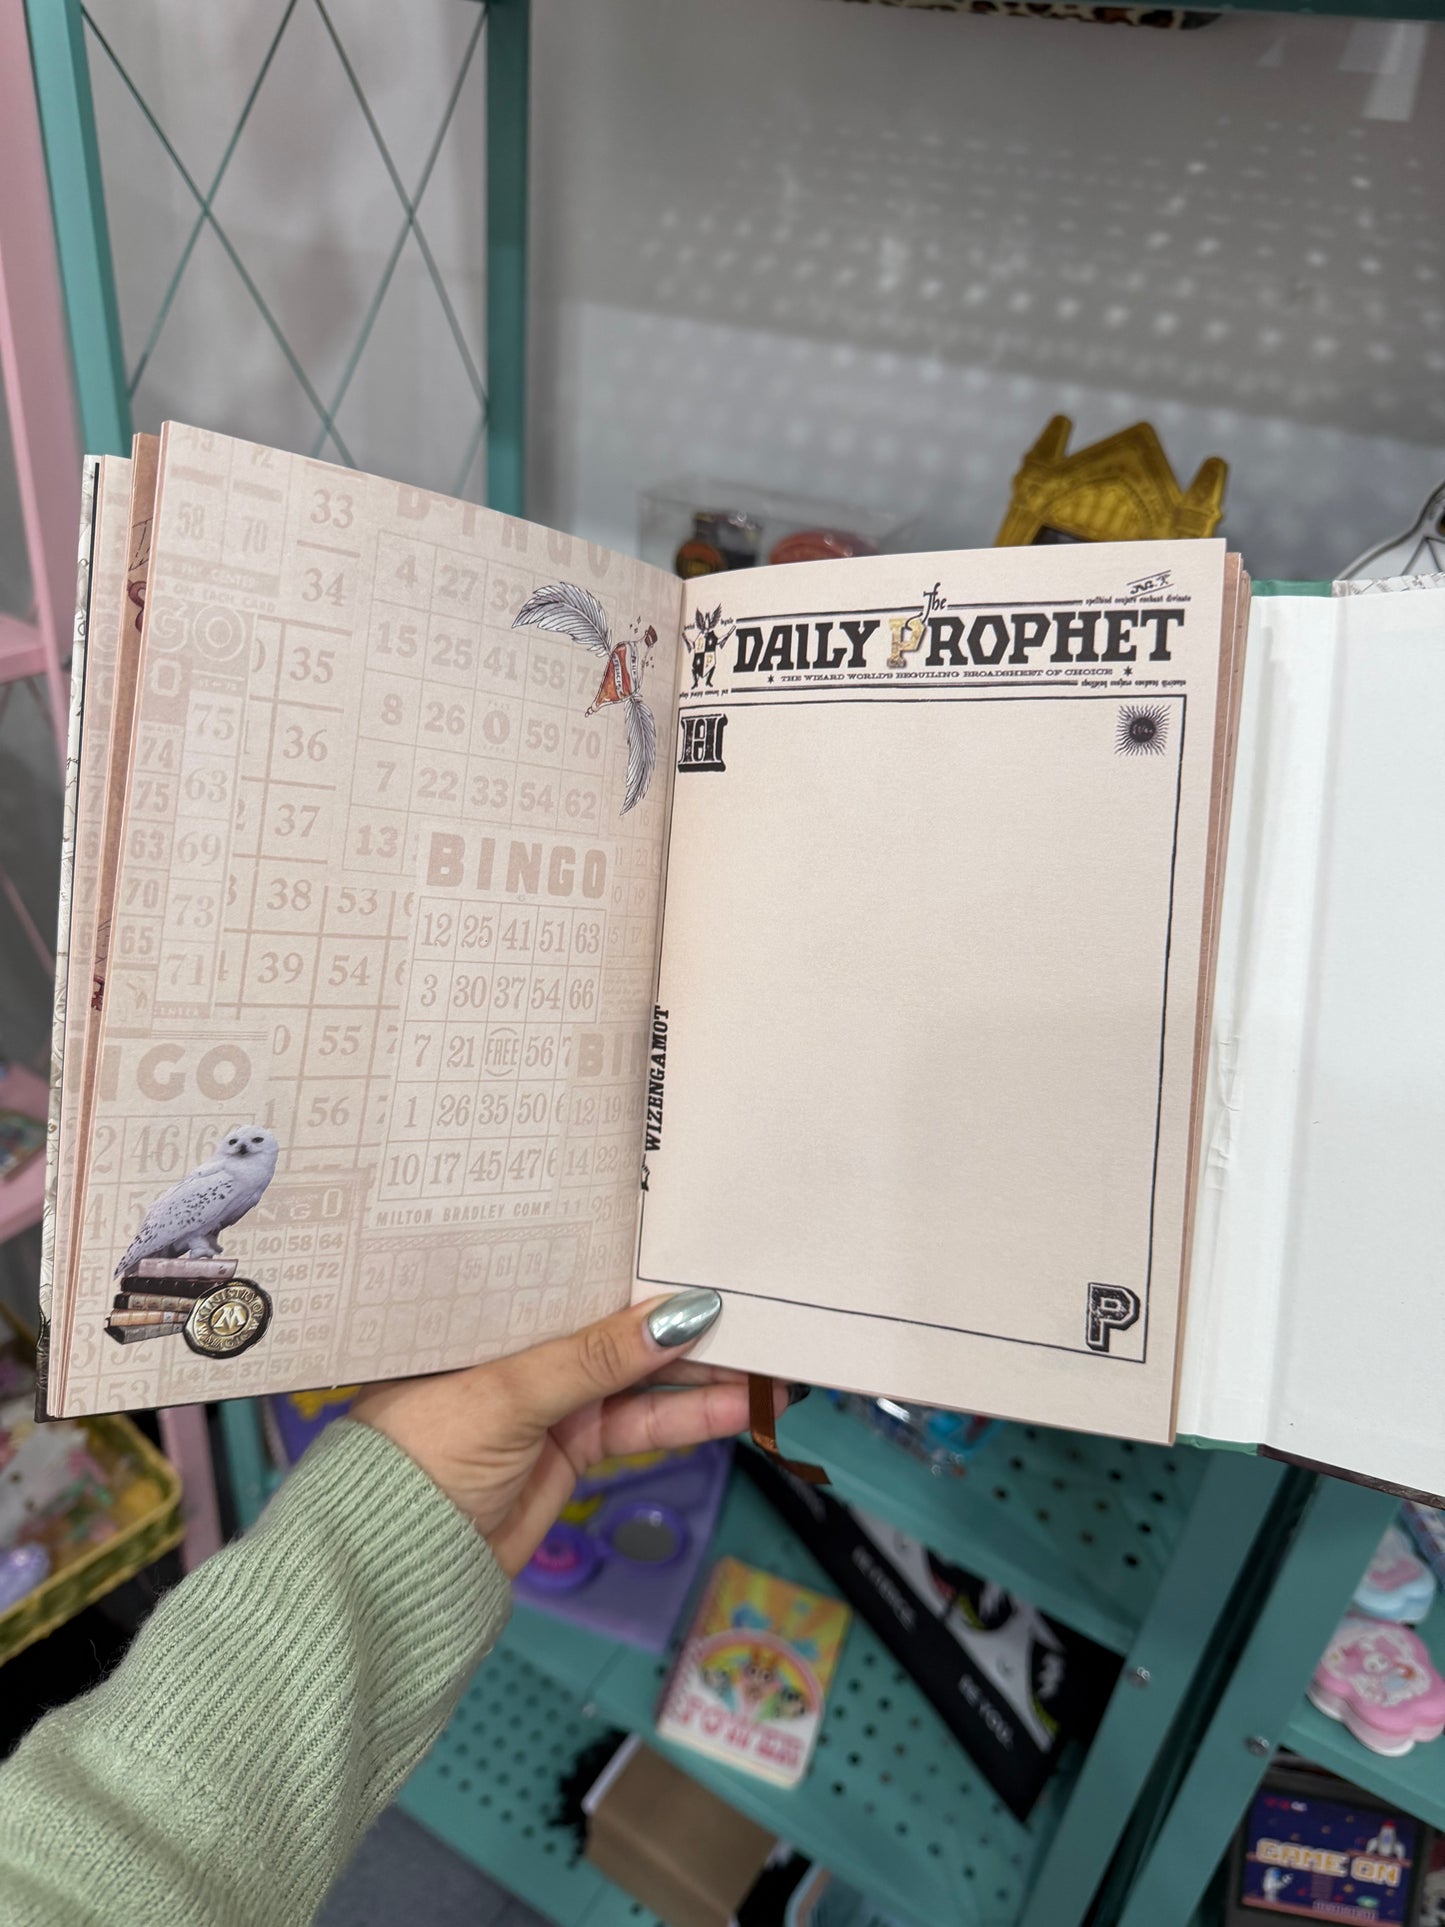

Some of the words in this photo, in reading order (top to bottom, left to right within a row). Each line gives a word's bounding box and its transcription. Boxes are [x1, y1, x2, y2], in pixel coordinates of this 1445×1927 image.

[310, 488, 354, 529] 33
[302, 567, 346, 608] 34
[395, 554, 418, 590] 4
[439, 563, 479, 601] 27
[915, 582, 947, 626] The
[377, 620, 418, 659] 15
[431, 633, 474, 672] 25
[483, 646, 518, 681] 41
[528, 654, 566, 690] 58
[733, 619, 881, 674] DAILY
[886, 608, 1185, 669] PROPHET
[289, 646, 335, 685] 35
[780, 675, 802, 683] THE
[804, 673, 845, 682] WIZARD
[896, 670, 960, 680] BEGUILING
[962, 668, 1044, 679] BROADSHEET
[1045, 668, 1063, 677] OF
[1064, 667, 1113, 677] CHOICE
[283, 725, 328, 762] 36
[380, 692, 404, 726] 8
[423, 701, 466, 736] 26
[525, 720, 560, 753] 59
[571, 726, 601, 759] 70
[134, 780, 170, 814] 75
[184, 767, 228, 804] 63
[377, 760, 397, 793] 7
[416, 766, 458, 801] 22
[471, 775, 509, 810] 33
[519, 781, 556, 813] 54
[564, 789, 596, 820] 62
[274, 803, 321, 838] 37
[129, 829, 166, 861] 63
[176, 831, 222, 867] 69
[355, 824, 398, 858] 13
[425, 831, 608, 899] BINGO
[125, 877, 160, 910] 70
[266, 877, 312, 912] 38
[336, 886, 378, 916] 53
[171, 895, 215, 929] 73
[120, 924, 155, 956] 65
[420, 912, 452, 948] 12
[461, 914, 494, 949] 25
[502, 918, 531, 951] 41
[539, 919, 566, 952] 51
[574, 922, 600, 955] 63
[166, 952, 206, 987] 71
[257, 952, 304, 985] 39
[328, 955, 370, 987] 54
[420, 973, 439, 1008] 3
[454, 974, 487, 1009] 30
[493, 975, 526, 1010] 37
[530, 976, 561, 1011] 54
[568, 979, 595, 1011] 66
[318, 1025, 362, 1056] 55
[414, 1033, 432, 1068] 7
[446, 1035, 476, 1068] 21
[484, 1036, 519, 1068] FREE
[524, 1034, 554, 1068] 56
[645, 1004, 670, 1152] WIZENGAMOT
[307, 1096, 350, 1128] 56
[403, 1095, 419, 1128] 1
[437, 1092, 471, 1127] 26
[478, 1093, 510, 1126] 35
[517, 1091, 548, 1125] 50
[131, 1124, 181, 1173] 46
[386, 1152, 420, 1188] 10
[428, 1151, 461, 1185] 17
[468, 1149, 502, 1182] 45
[507, 1148, 542, 1181] 47
[376, 1206, 433, 1227] MILTON
[442, 1200, 505, 1223] BRADLEY
[259, 1236, 283, 1253] 40
[287, 1234, 313, 1252] 58
[318, 1232, 343, 1250] 64
[282, 1264, 308, 1282] 48
[314, 1261, 339, 1280] 72
[198, 1286, 257, 1321] MINISTRY
[277, 1297, 301, 1315] 60
[310, 1293, 335, 1311] 67
[1085, 1281, 1141, 1353] P
[275, 1328, 299, 1345] 46
[305, 1324, 329, 1342] 69
[269, 1355, 294, 1375] 57
[1256, 1838, 1350, 1878] GAME
[1350, 1856, 1402, 1888] ON
